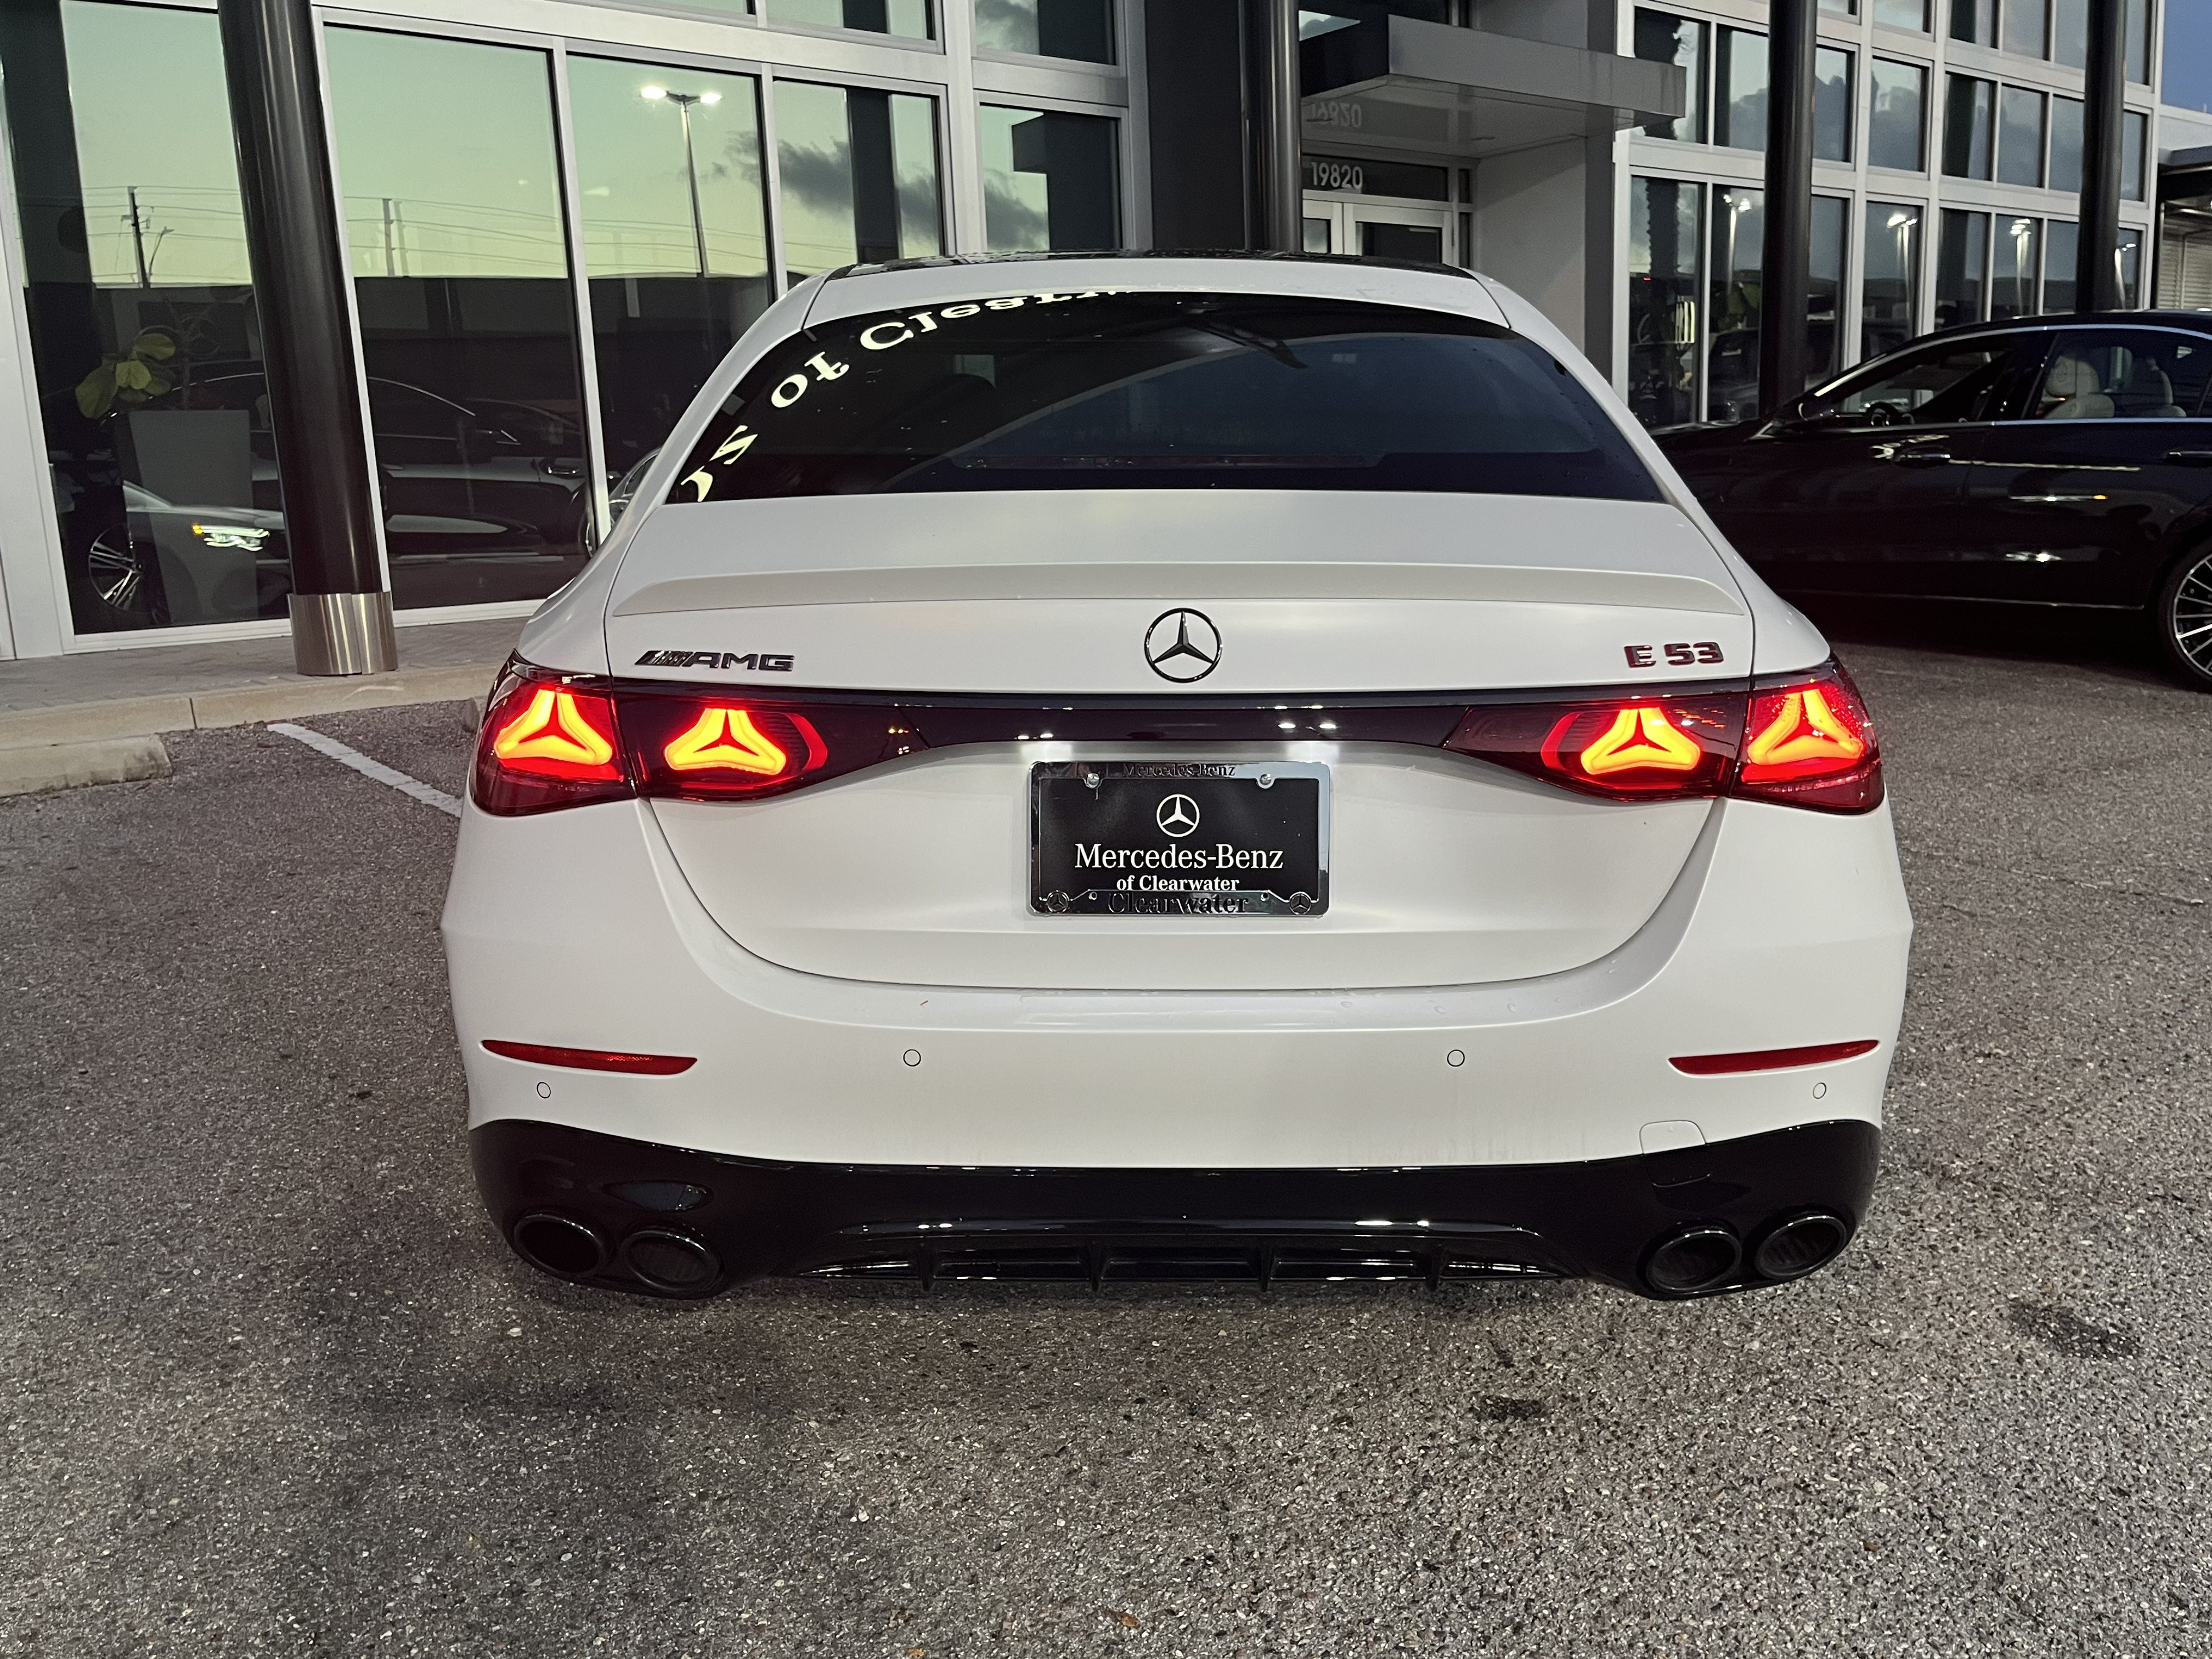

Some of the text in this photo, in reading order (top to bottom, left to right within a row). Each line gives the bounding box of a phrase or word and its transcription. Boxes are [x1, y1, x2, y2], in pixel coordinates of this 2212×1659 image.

[1311, 162, 1363, 189] 19820
[682, 651, 795, 672] AMG
[1624, 641, 1724, 668] E 53
[1074, 843, 1284, 869] Mercedes-Benz
[1116, 875, 1240, 891] of Clearwater
[1108, 892, 1249, 915] Clearwater
